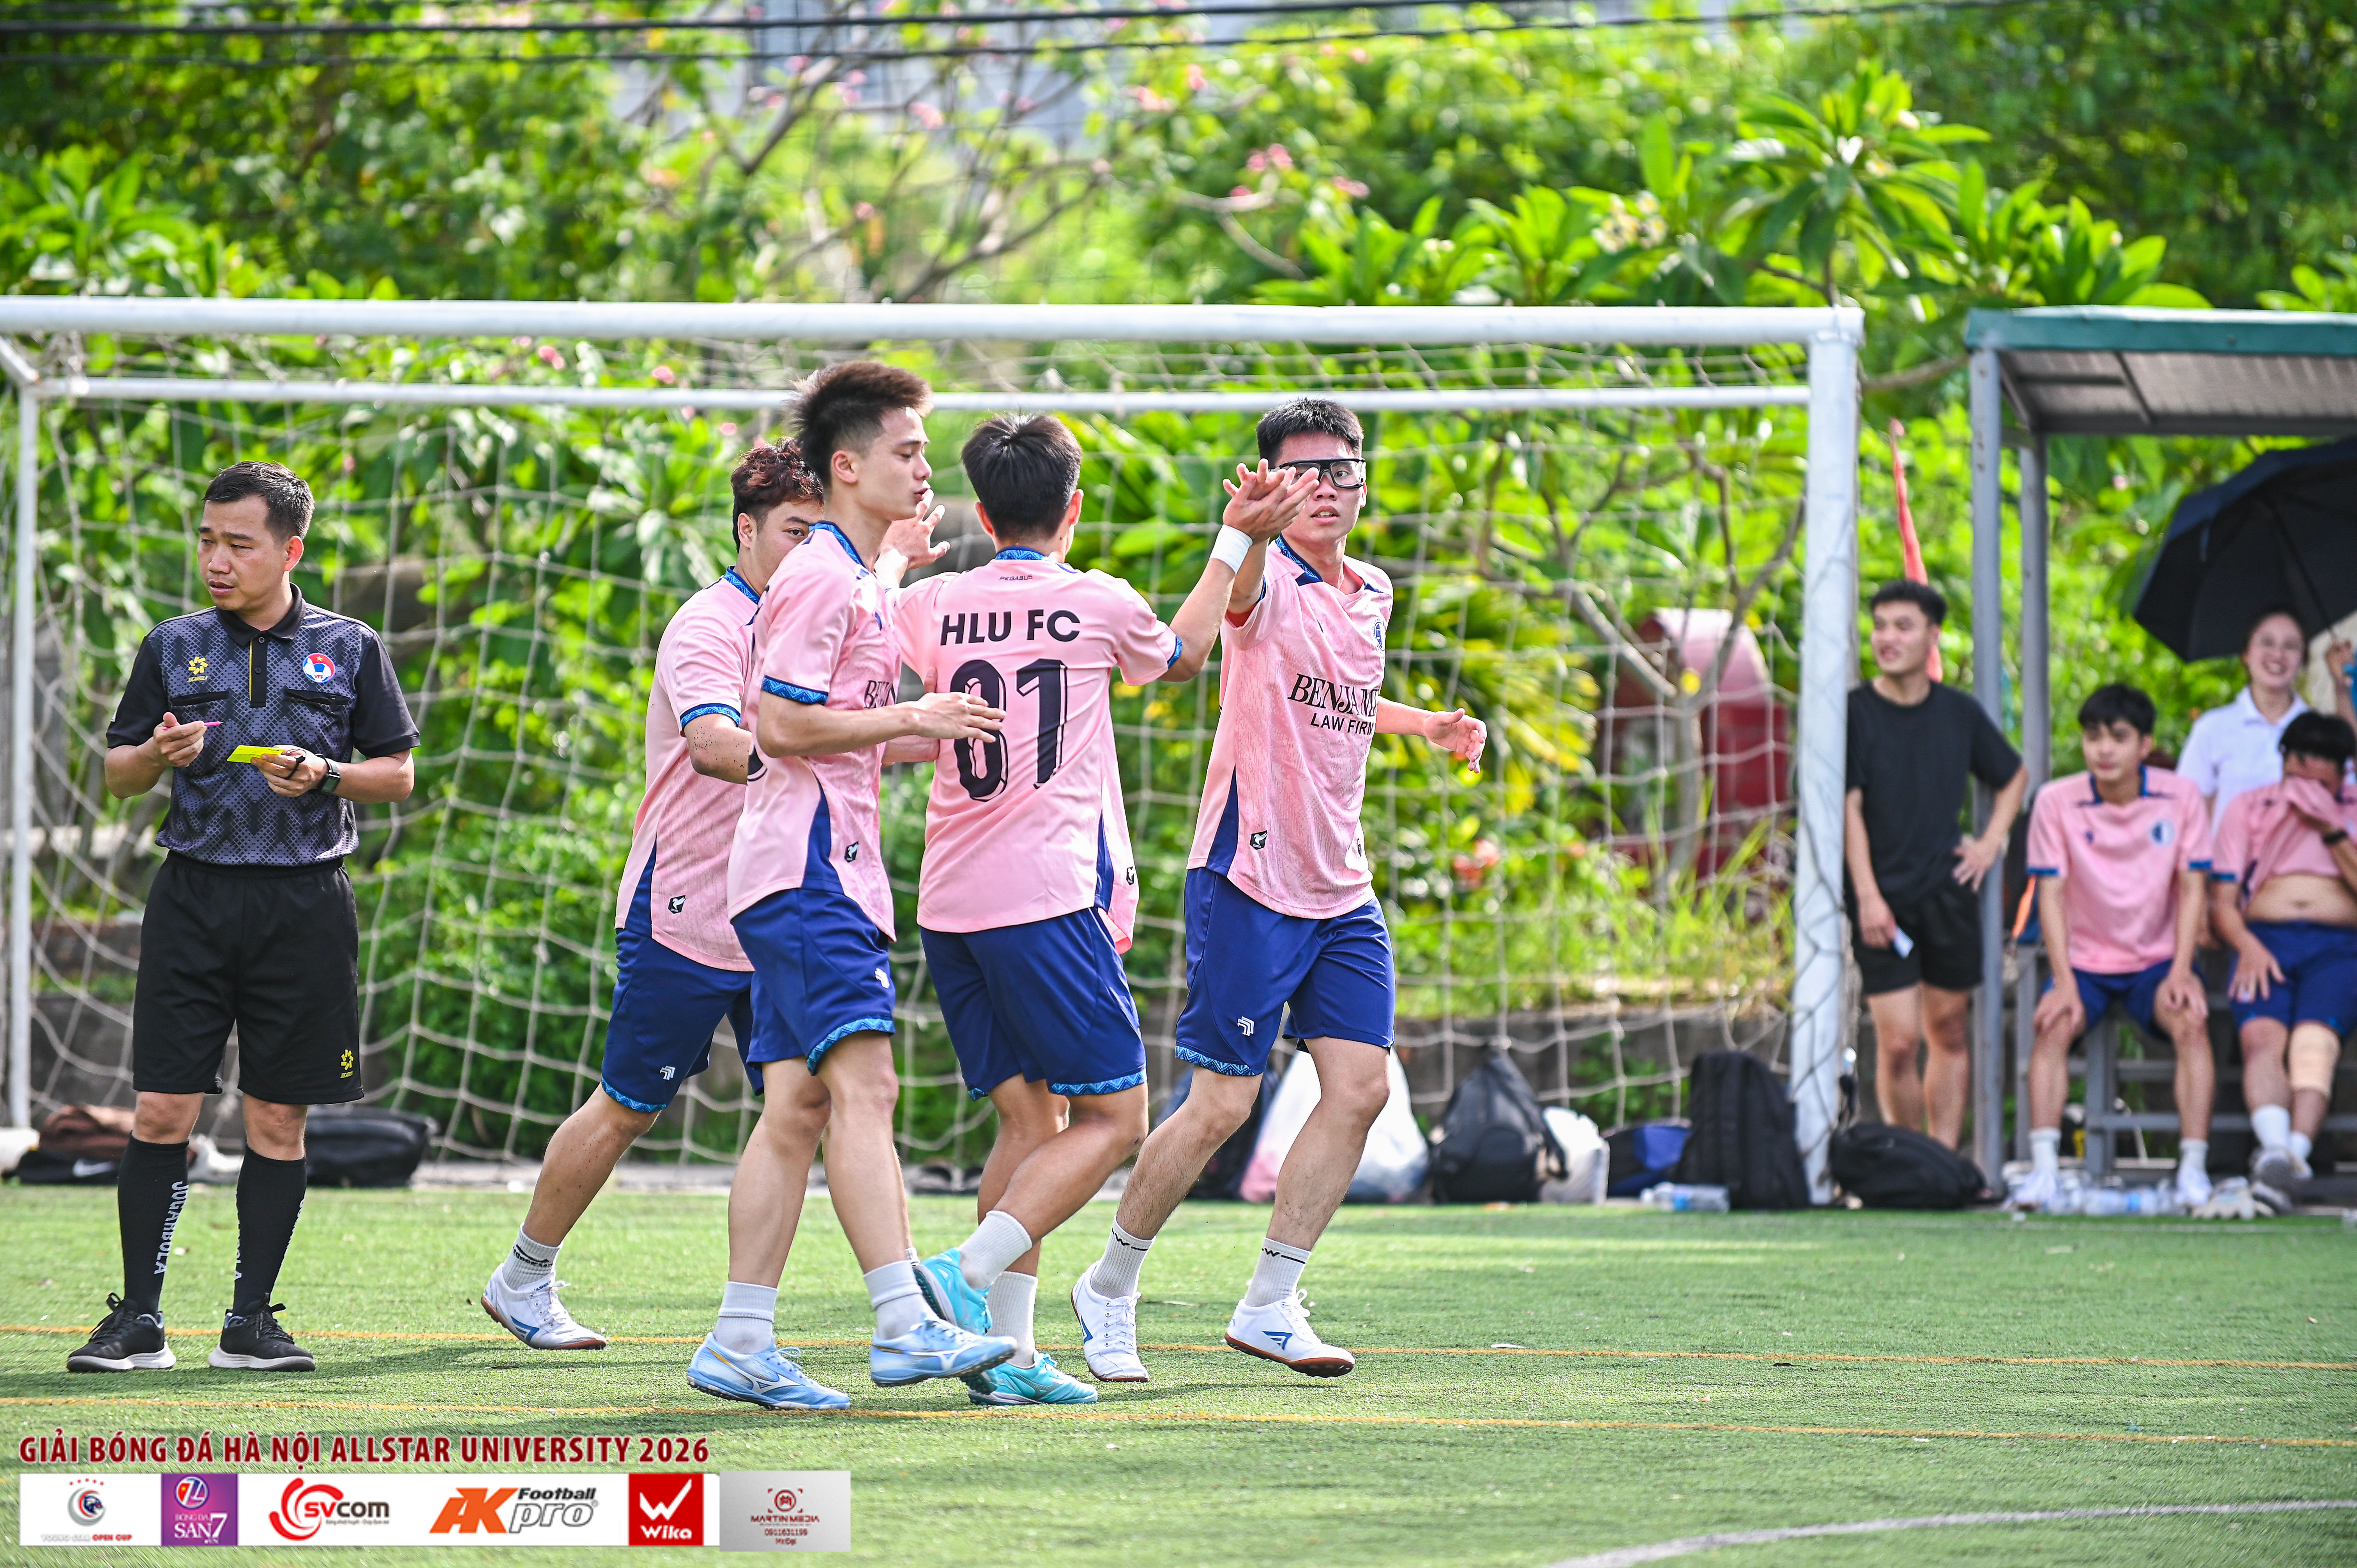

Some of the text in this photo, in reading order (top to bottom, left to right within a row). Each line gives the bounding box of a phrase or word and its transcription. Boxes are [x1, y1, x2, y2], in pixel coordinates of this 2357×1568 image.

[940, 609, 1080, 646] HLU FC
[949, 658, 1067, 802] 81
[1310, 713, 1345, 731] LAW
